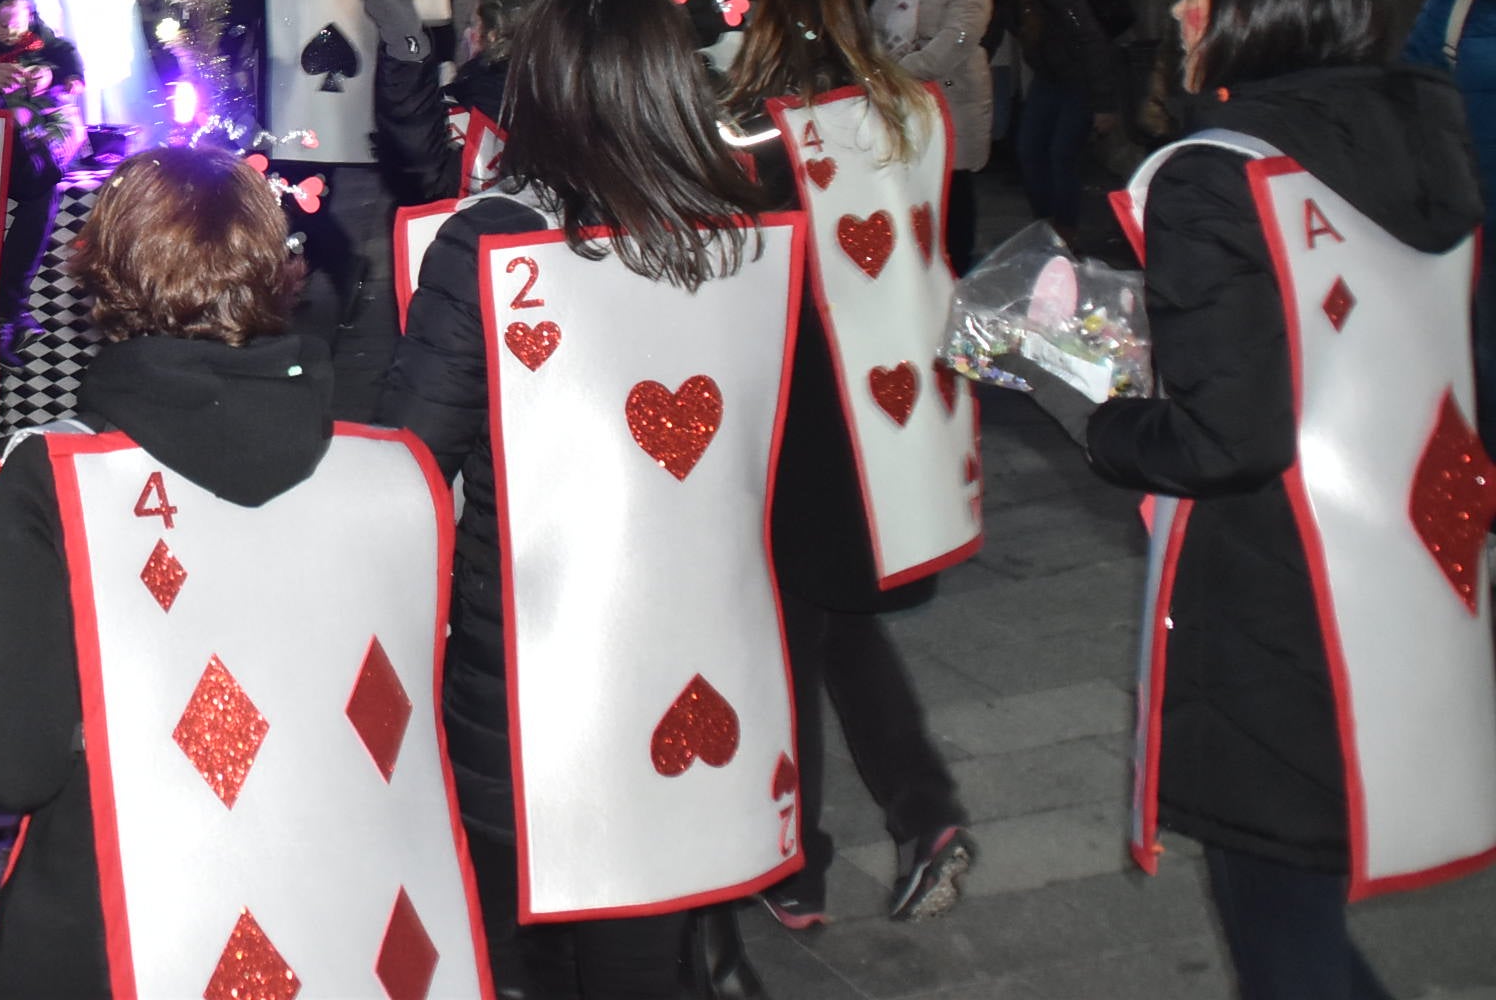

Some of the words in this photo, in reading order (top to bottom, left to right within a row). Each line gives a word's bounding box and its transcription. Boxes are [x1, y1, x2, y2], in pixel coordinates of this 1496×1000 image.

[801, 119, 824, 153] 4
[1303, 197, 1346, 250] A
[505, 256, 545, 310] 2
[133, 470, 178, 530] 4
